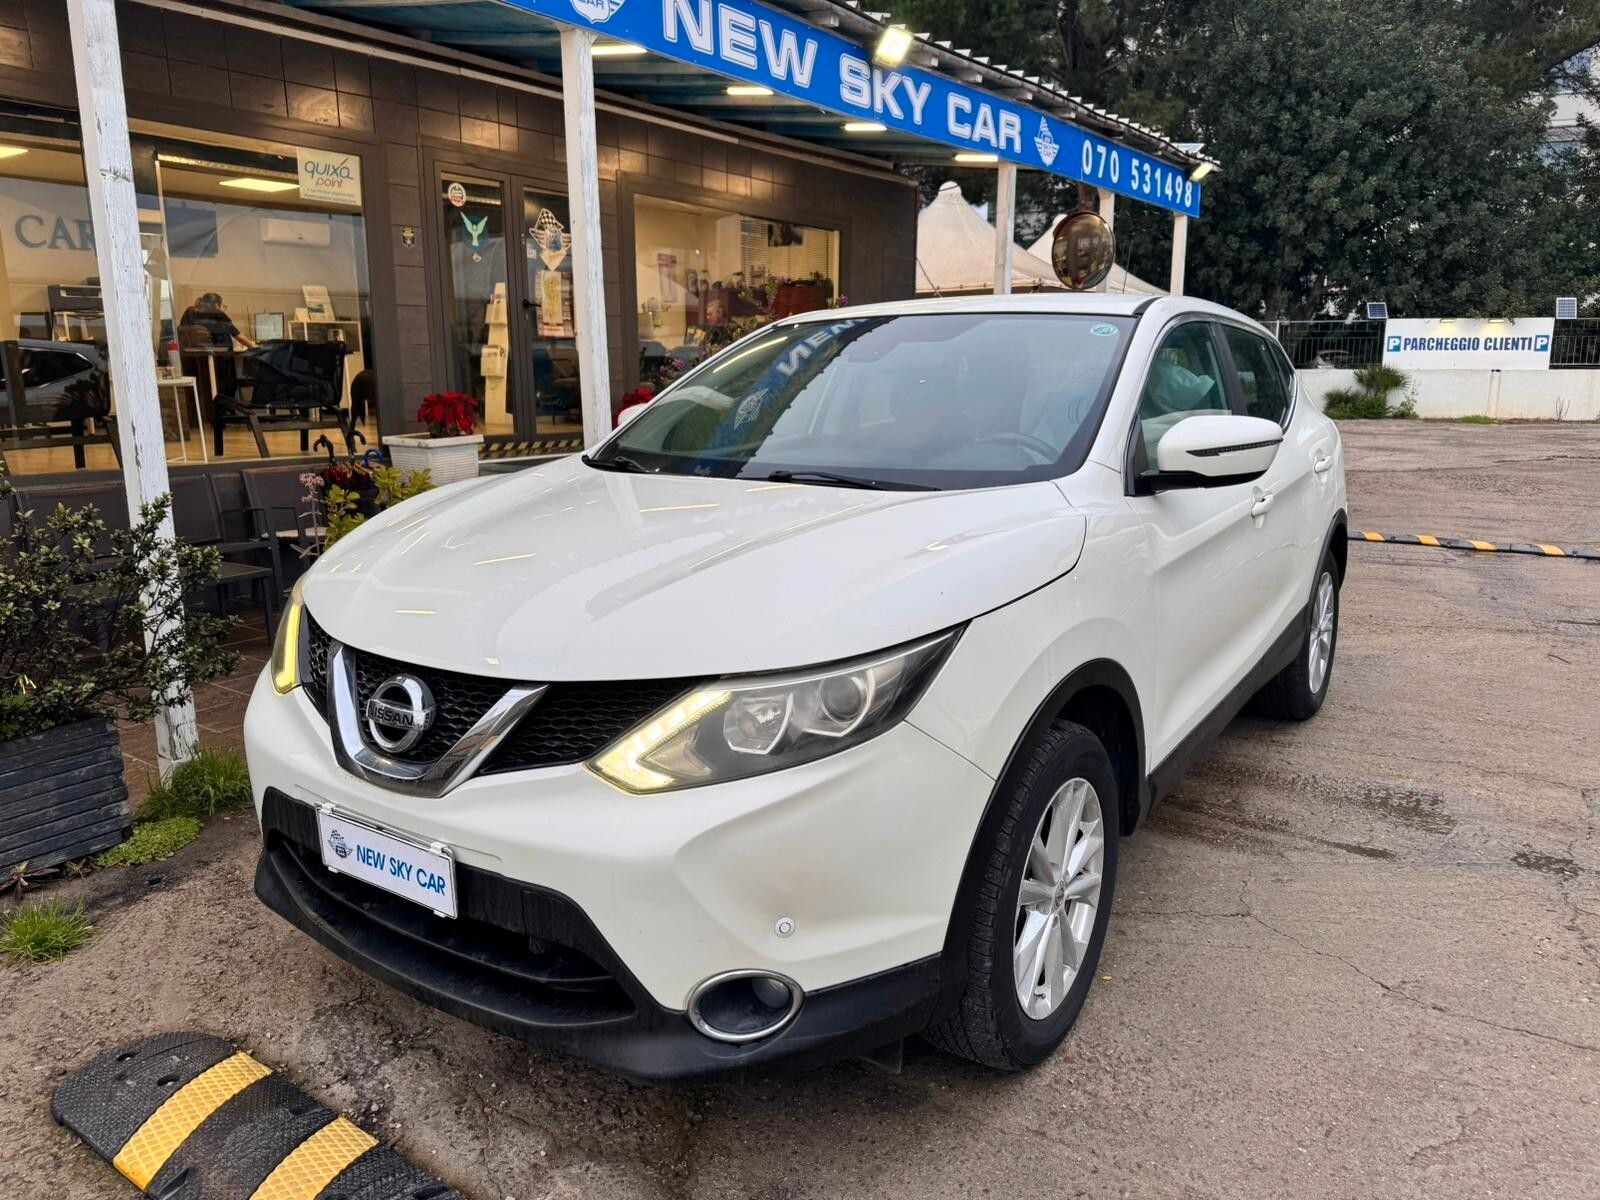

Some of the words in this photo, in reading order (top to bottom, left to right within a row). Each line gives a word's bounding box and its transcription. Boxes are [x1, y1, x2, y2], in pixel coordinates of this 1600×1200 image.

[663, 0, 818, 88] NEW
[839, 53, 932, 125] SKY
[947, 92, 1022, 153] CAR
[304, 158, 354, 180] quixa
[1082, 139, 1119, 184] 070
[1131, 158, 1192, 208] 531498
[315, 177, 343, 189] point
[1403, 337, 1480, 351] PARCHEGGIO
[1484, 336, 1532, 351] CLIENTI
[368, 700, 414, 726] NISSAN
[357, 844, 386, 871] NEW
[390, 857, 412, 882] SKY
[416, 868, 445, 896] CAR
